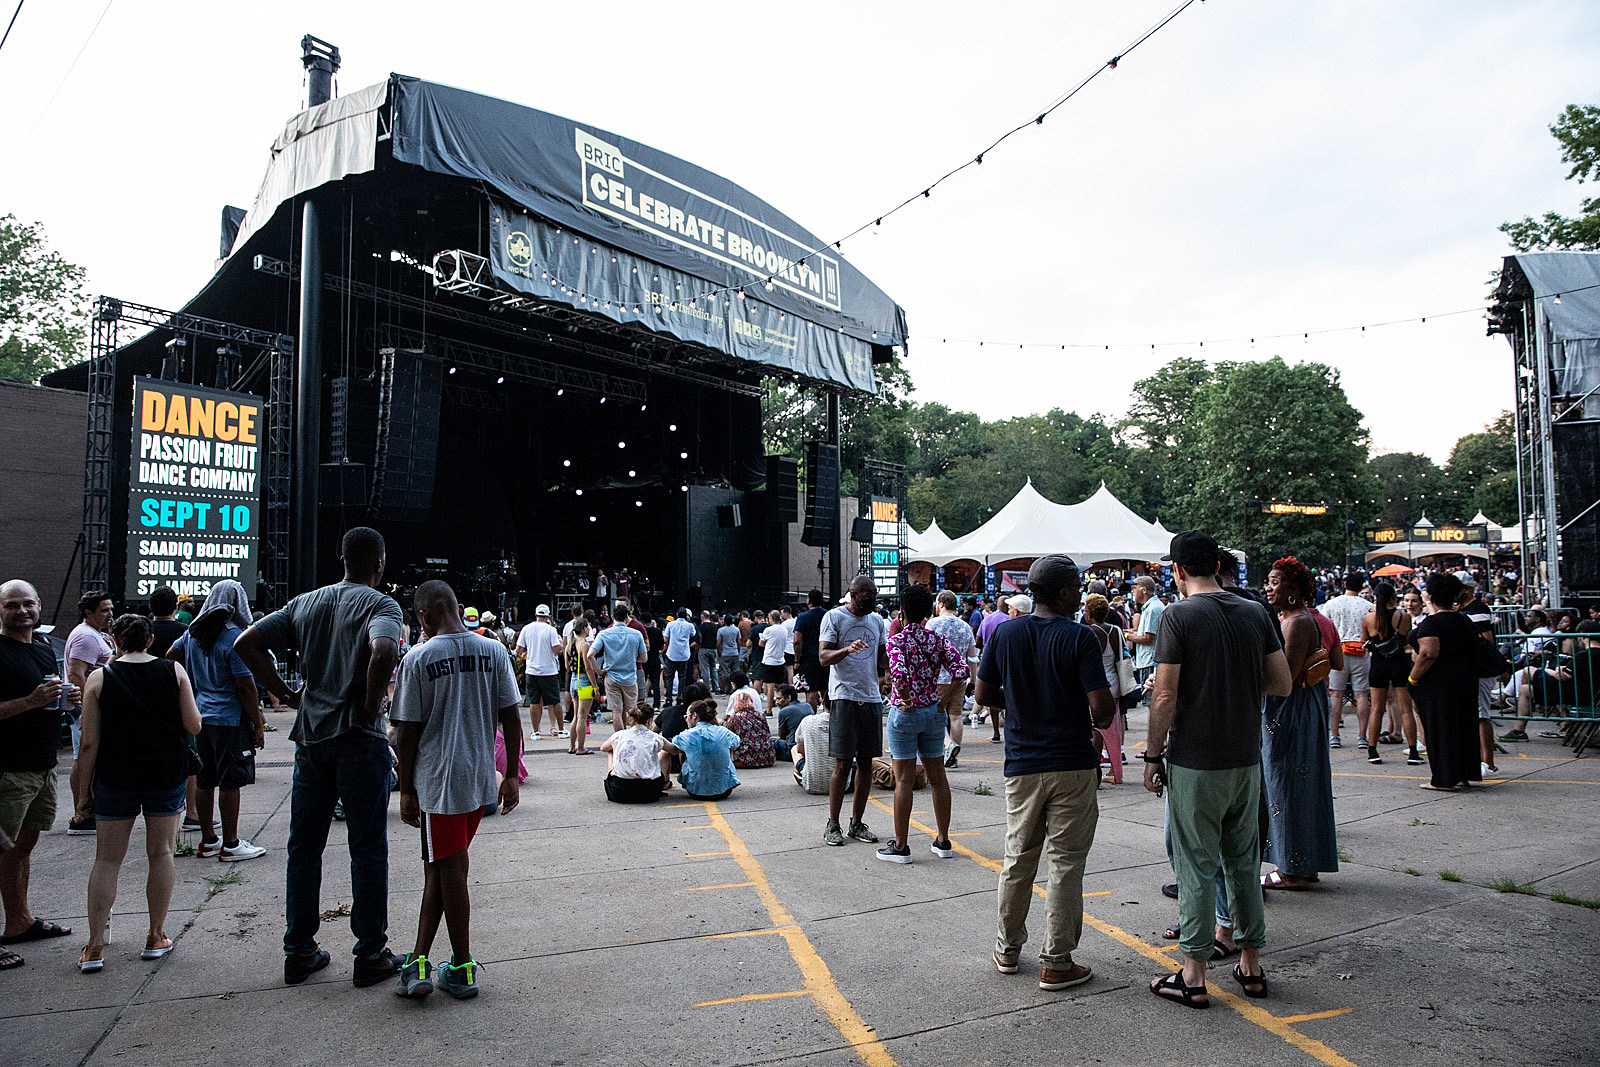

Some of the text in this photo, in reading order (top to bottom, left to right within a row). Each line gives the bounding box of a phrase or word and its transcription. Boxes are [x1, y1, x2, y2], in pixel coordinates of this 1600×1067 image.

[583, 142, 620, 173] BRIC
[590, 172, 725, 251] CELEBRATE
[727, 231, 820, 294] BROOKLYN
[141, 389, 258, 444] DANCE
[140, 433, 258, 470] PASSION FRUIT
[139, 461, 256, 493] DANCE COMPANY
[140, 498, 250, 533] SEPT 10
[872, 501, 898, 522] DANCE
[1375, 529, 1396, 542] INFO
[1431, 529, 1464, 541] INFO
[139, 540, 250, 560] SAADIQ BOLDEN
[873, 550, 898, 565] SEPT 10
[138, 560, 240, 577] SOUL SUMMIT
[425, 657, 456, 683] JUST
[458, 655, 476, 673] DO
